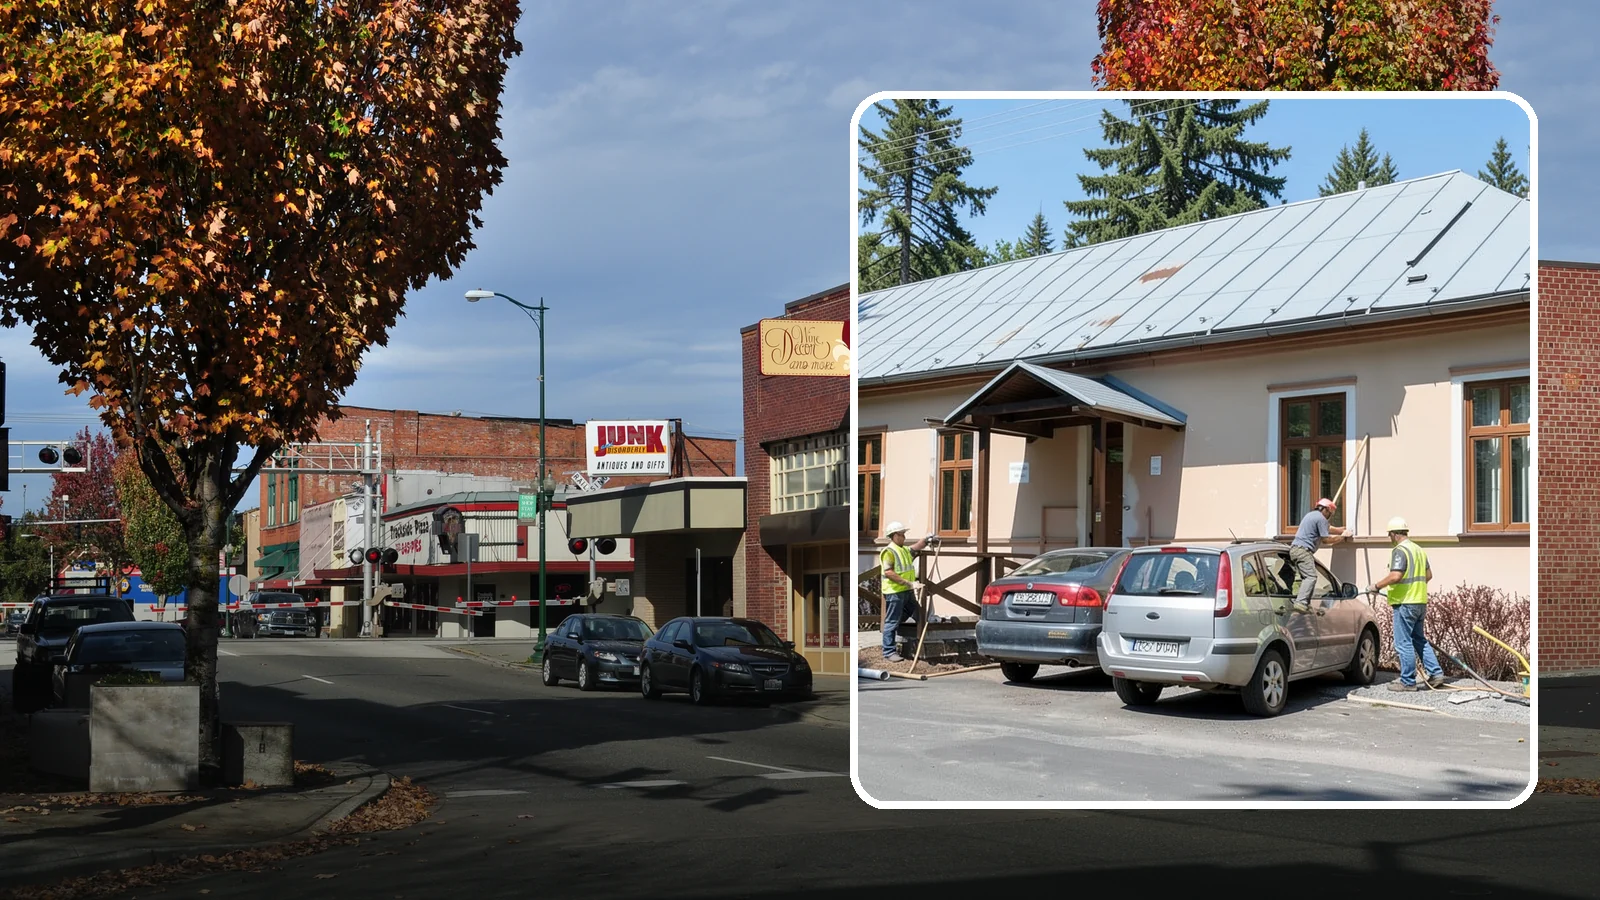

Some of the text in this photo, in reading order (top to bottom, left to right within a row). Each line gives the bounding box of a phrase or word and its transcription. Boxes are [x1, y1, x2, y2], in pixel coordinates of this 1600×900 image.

[595, 425, 665, 457] JUNK
[607, 446, 646, 454] DISORDERLY
[597, 460, 665, 470] ANTIQUES AND GIFTS
[390, 519, 429, 540] Trackside Pizza
